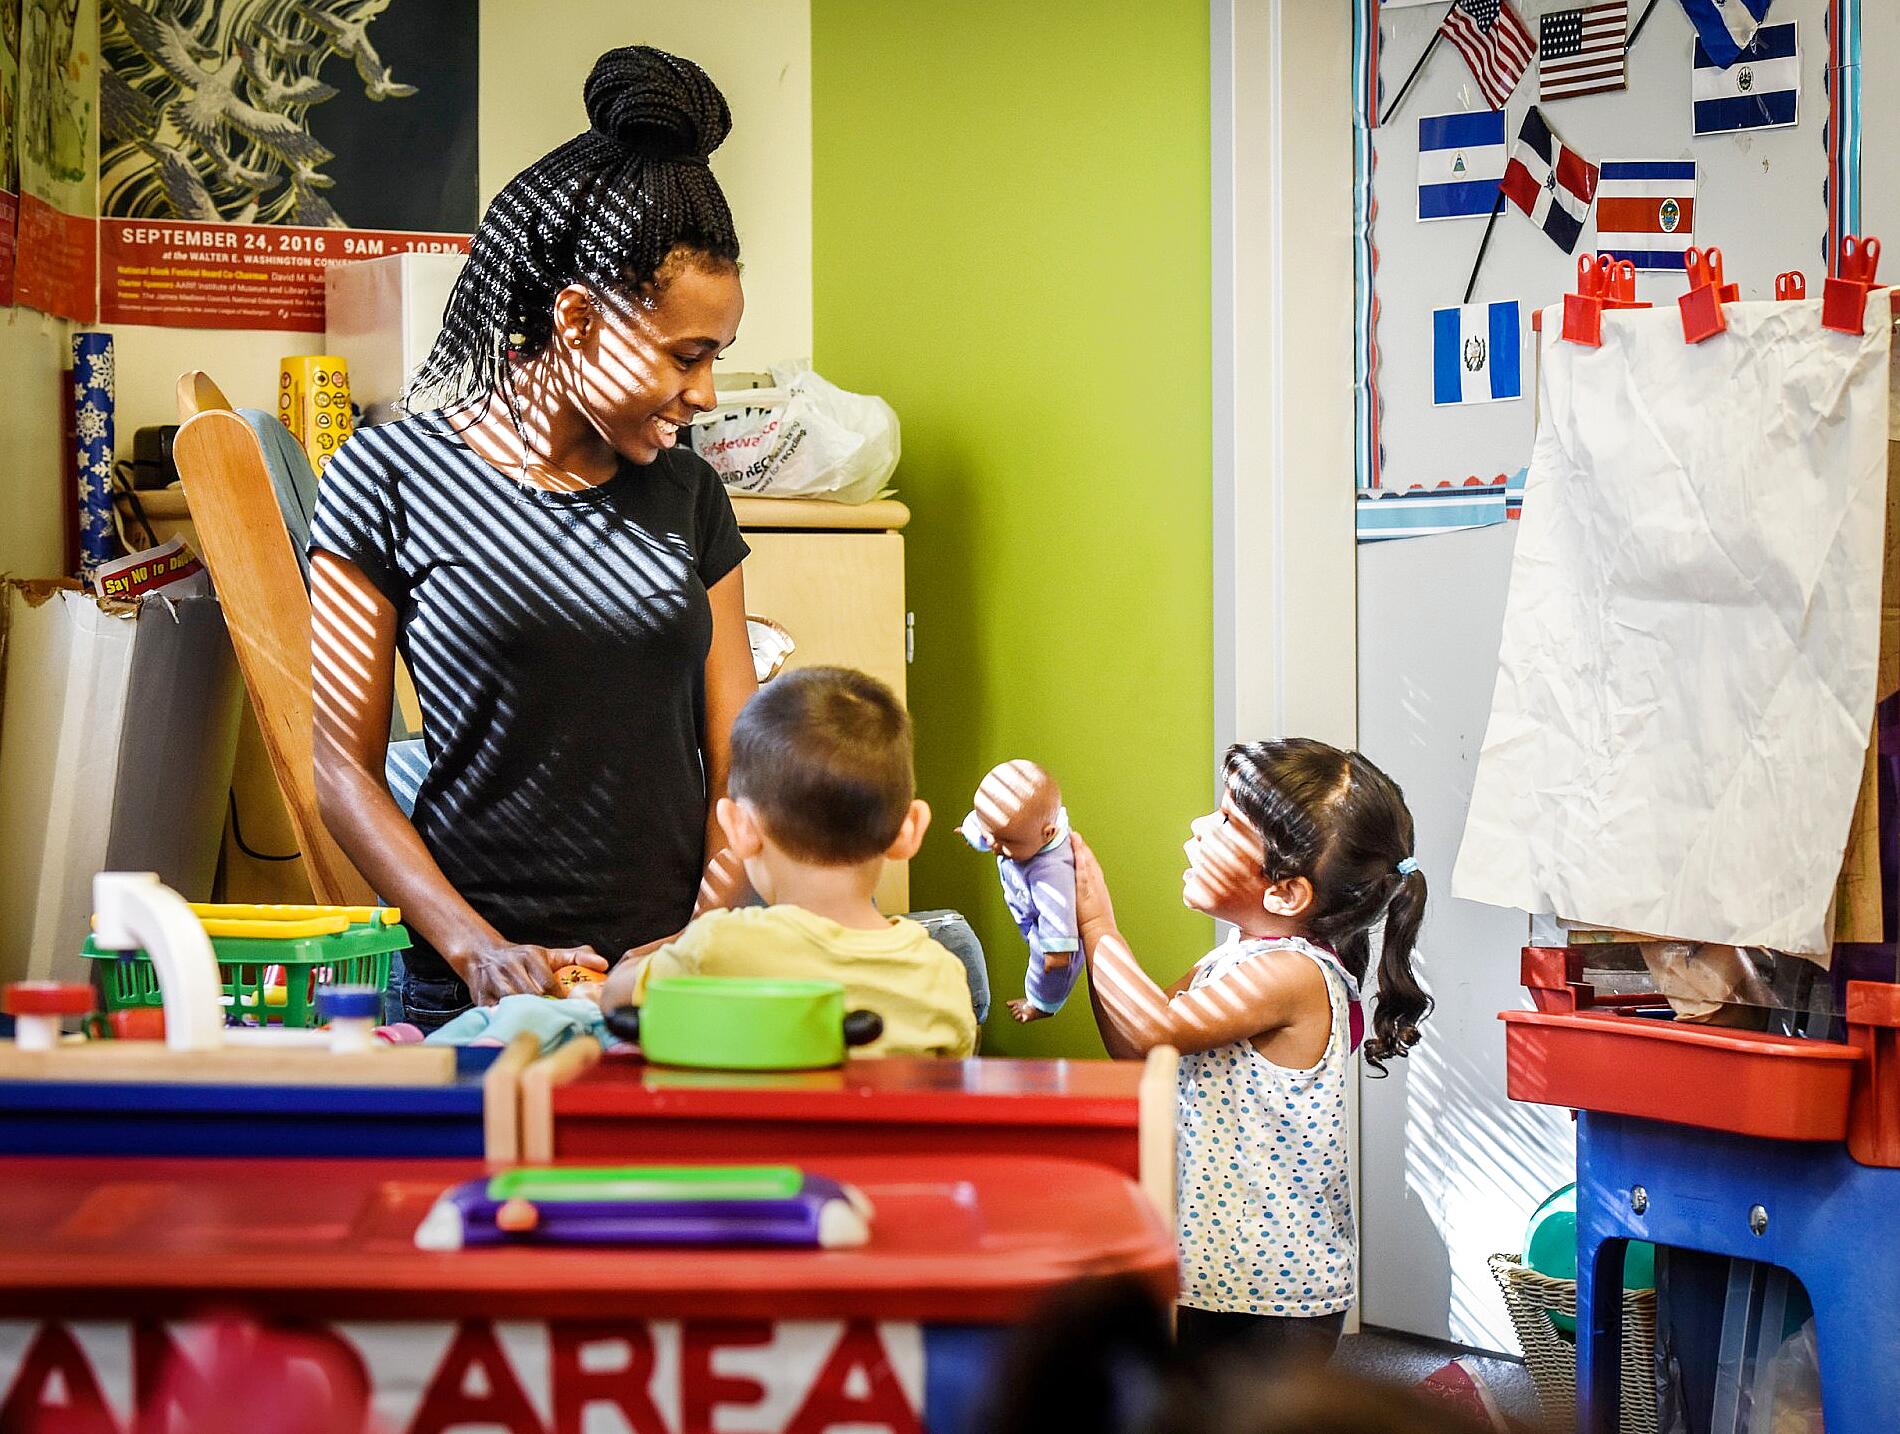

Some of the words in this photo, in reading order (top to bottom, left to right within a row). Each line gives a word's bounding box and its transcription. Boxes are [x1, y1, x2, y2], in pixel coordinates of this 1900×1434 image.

[122, 228, 237, 248] SEPTEMBER
[244, 234, 272, 253] 24,
[280, 235, 325, 252] 2016
[344, 238, 384, 255] 9AM
[406, 241, 459, 254] 10PM
[162, 251, 172, 260] at
[173, 251, 187, 260] the
[190, 252, 229, 262] WALTER
[231, 254, 241, 263] E.
[243, 254, 311, 267] WASHINGTON
[271, 271, 294, 282] David
[105, 577, 130, 595] Say
[131, 567, 148, 584] NO
[153, 563, 165, 577] to
[405, 1318, 922, 1434] AREA
